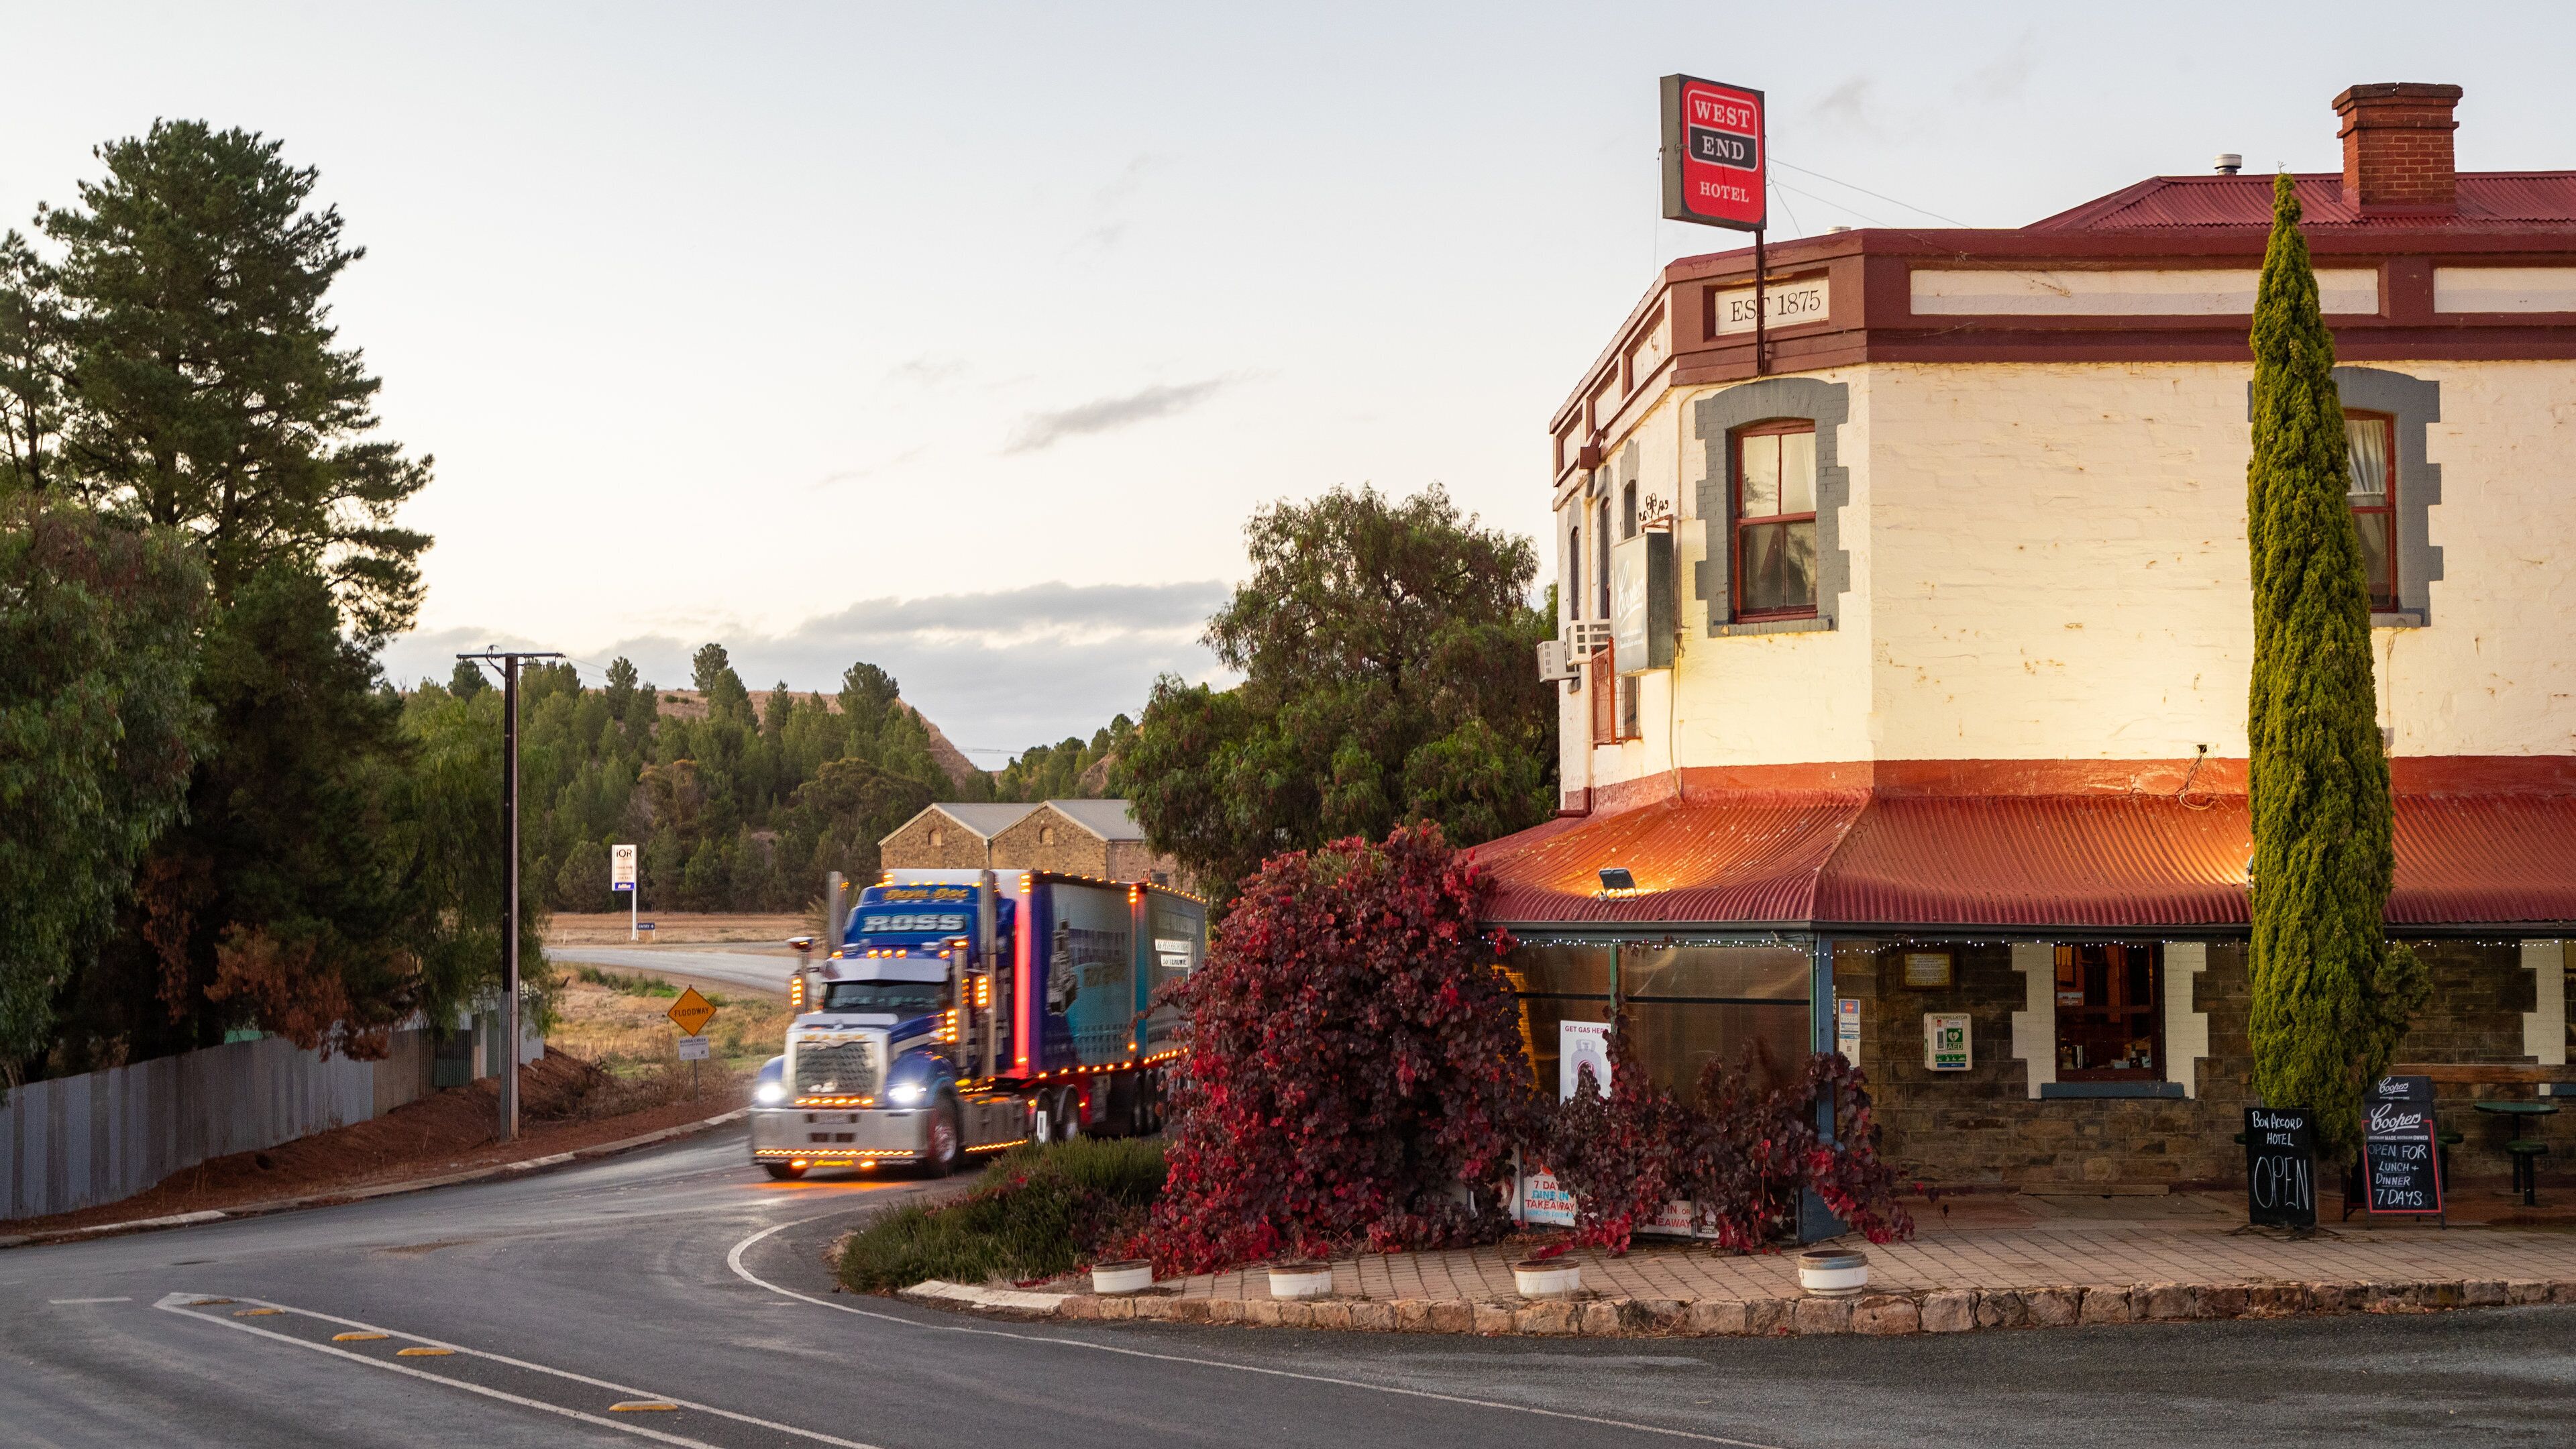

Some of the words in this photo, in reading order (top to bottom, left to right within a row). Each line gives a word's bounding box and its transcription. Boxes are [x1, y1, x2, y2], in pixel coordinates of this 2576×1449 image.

[1695, 100, 1750, 127] WEST
[1702, 136, 1745, 160] END
[1700, 181, 1750, 203] HOTEL
[1778, 290, 1821, 315] 1875
[861, 914, 965, 932] ROSS
[674, 1007, 709, 1017] FLOODWAY
[2379, 1077, 2409, 1095] Coopers
[2271, 1113, 2303, 1130] ACCORD
[2371, 1104, 2421, 1134] Coopers
[2266, 1132, 2294, 1146] HOTEL
[2367, 1144, 2396, 1157] OPEN
[2402, 1144, 2426, 1160] FOR
[2379, 1161, 2409, 1171] LUNCH
[1534, 1181, 1540, 1189] 7
[2255, 1155, 2308, 1210] OPEN
[2376, 1173, 2410, 1186] DINNER
[1532, 1190, 1556, 1199] DINE
[1559, 1191, 1569, 1201] IN
[2376, 1189, 2385, 1205] 7
[2387, 1189, 2422, 1205] DAYS
[1525, 1199, 1574, 1211] TAKEAWAY
